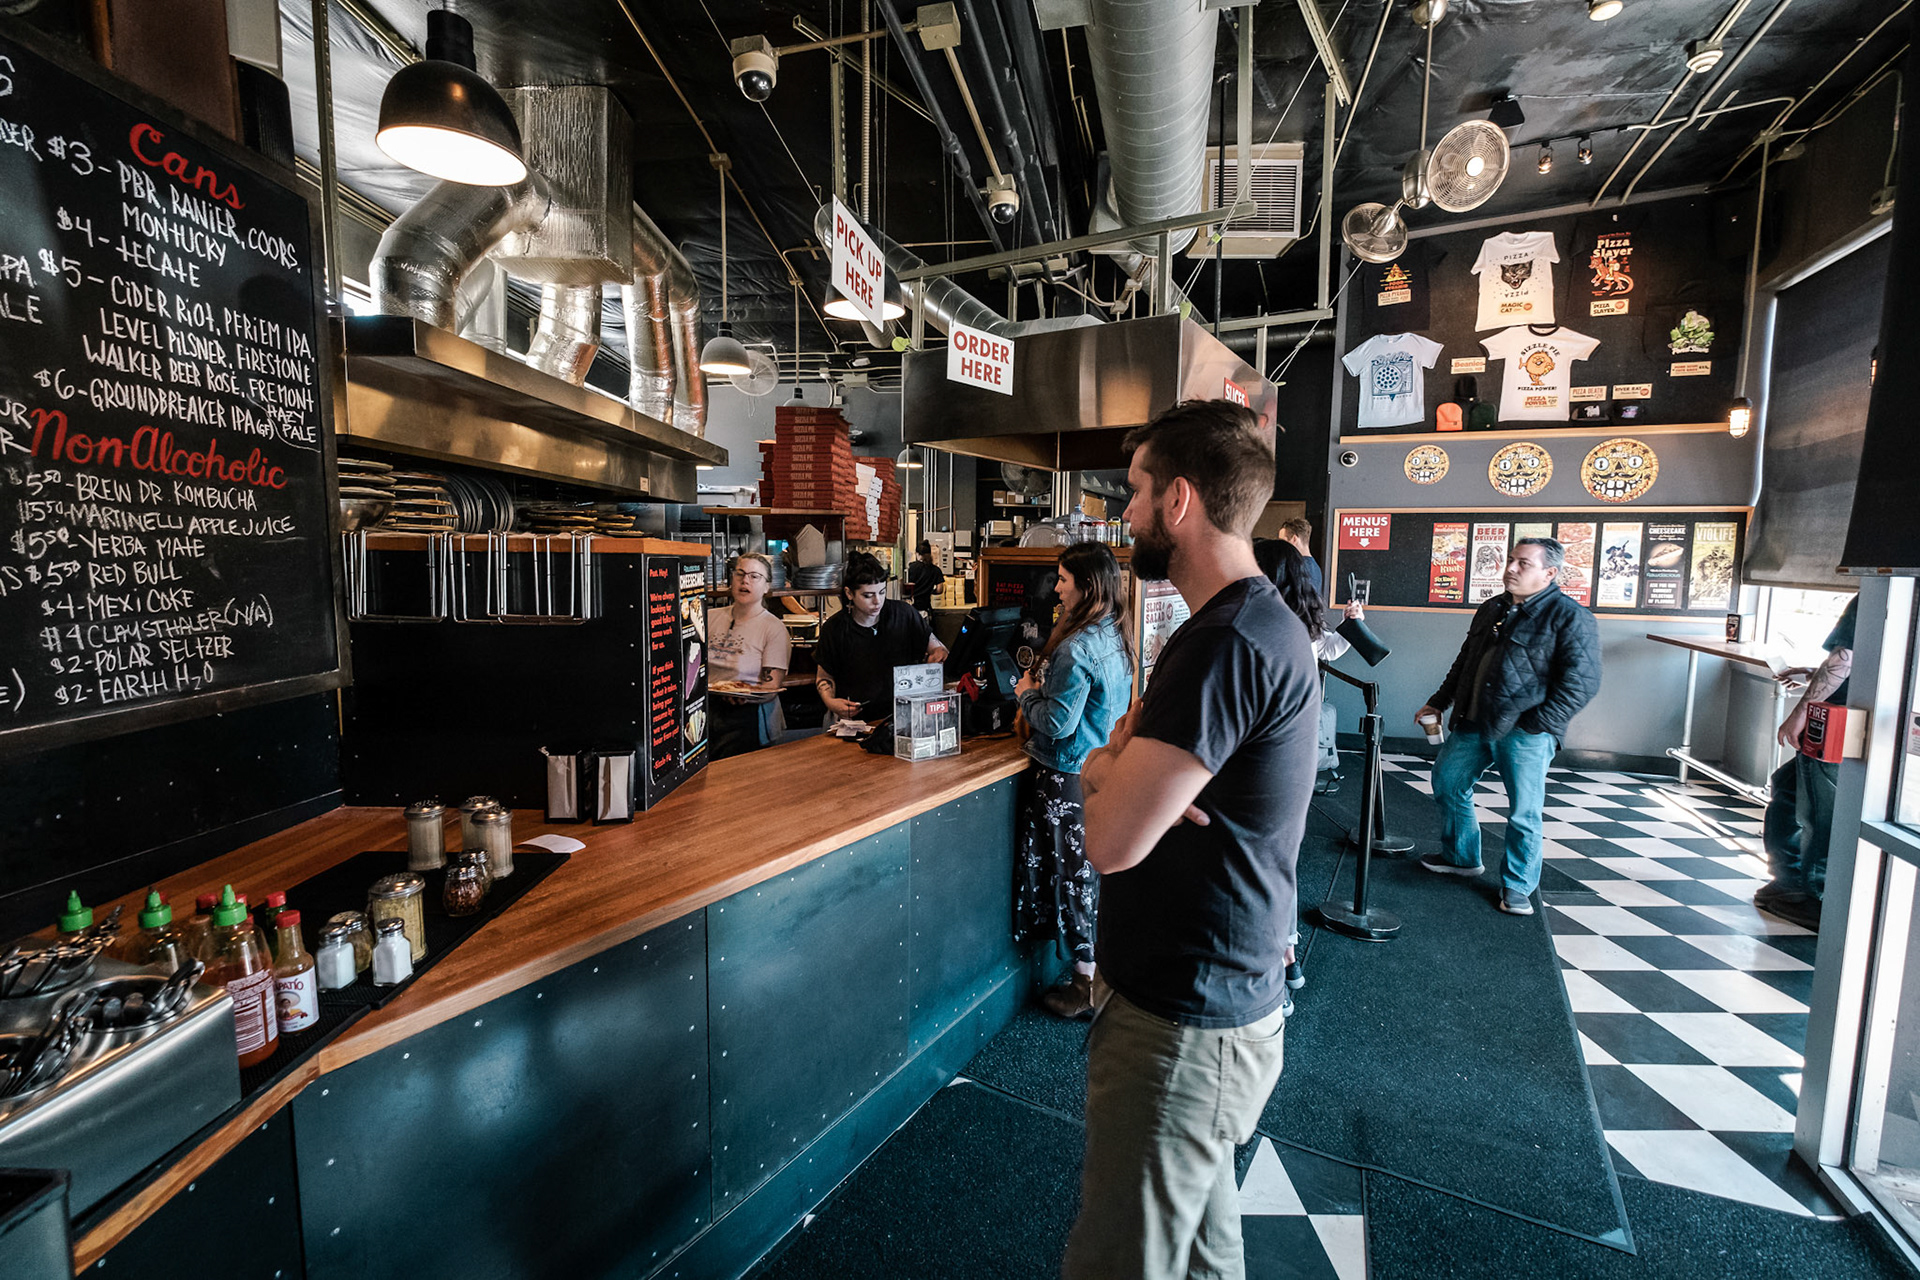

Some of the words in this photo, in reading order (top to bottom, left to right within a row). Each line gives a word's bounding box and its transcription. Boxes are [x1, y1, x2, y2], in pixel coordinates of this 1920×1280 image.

[129, 122, 246, 210] Cans
[122, 201, 227, 267] MONTUCKY
[1596, 239, 1630, 249] Pizza
[836, 213, 865, 266] PICK
[867, 254, 882, 283] UP
[1503, 252, 1530, 260] PIZZA
[1592, 247, 1634, 258] Slayer
[115, 235, 201, 288] TECATE
[845, 261, 873, 310] HERE
[111, 275, 172, 319] CIDER
[100, 307, 163, 350] LEVEL
[236, 343, 313, 386] FIRESTONE
[953, 330, 1010, 364] ORDER
[1520, 342, 1548, 357] SIZZLE
[1549, 345, 1561, 357] PIE
[82, 334, 163, 383] WALKER
[169, 358, 201, 387] BEER
[249, 378, 314, 413] FREMONT
[961, 357, 1002, 386] HERE
[90, 378, 227, 428] GROUNDBREAKER
[266, 404, 305, 426] HAZY
[282, 423, 317, 443] PALE
[76, 472, 132, 503] BREW
[173, 480, 258, 511] KOMBUCHA
[188, 516, 242, 536] APPLE
[242, 516, 295, 536] JUICE
[1342, 516, 1388, 526] MENUS
[1349, 527, 1380, 537] HERE
[1476, 527, 1505, 536] BEER
[1648, 527, 1686, 535] CHEESECAKE
[78, 529, 147, 558] YERBA
[156, 536, 205, 560] MATE
[1695, 527, 1735, 541] VIOLIFE
[88, 561, 127, 590] RED
[133, 559, 183, 585] BULL
[1440, 564, 1465, 574] Knots
[146, 587, 194, 613] COKE
[1146, 601, 1162, 612] SLICE
[1145, 611, 1165, 624] SALAD
[95, 641, 154, 676] POLAR
[159, 634, 235, 663] SELTZER
[100, 669, 168, 704] EARTH
[929, 703, 945, 712] TIPS
[1808, 705, 1828, 721] FIRE
[274, 978, 304, 993] PATÍO
